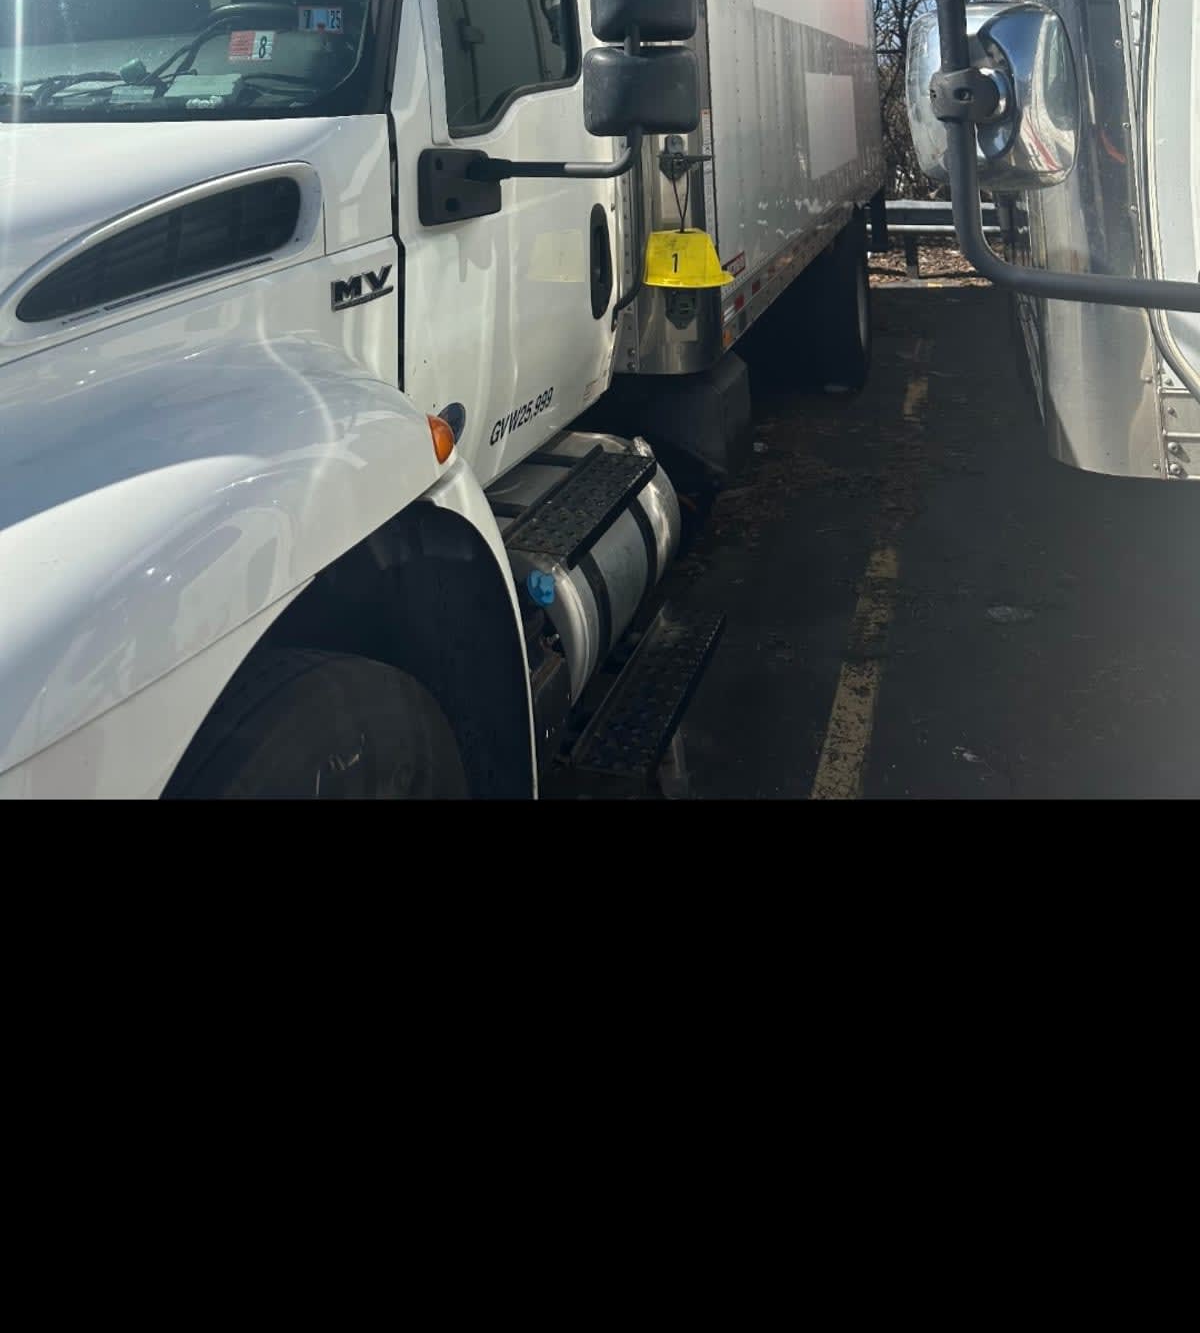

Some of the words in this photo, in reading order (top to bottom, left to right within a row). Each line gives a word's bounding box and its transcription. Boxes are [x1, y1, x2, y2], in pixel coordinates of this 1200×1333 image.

[327, 9, 341, 29] 25
[258, 35, 268, 59] 8
[671, 252, 679, 274] 1
[330, 264, 393, 306] MV
